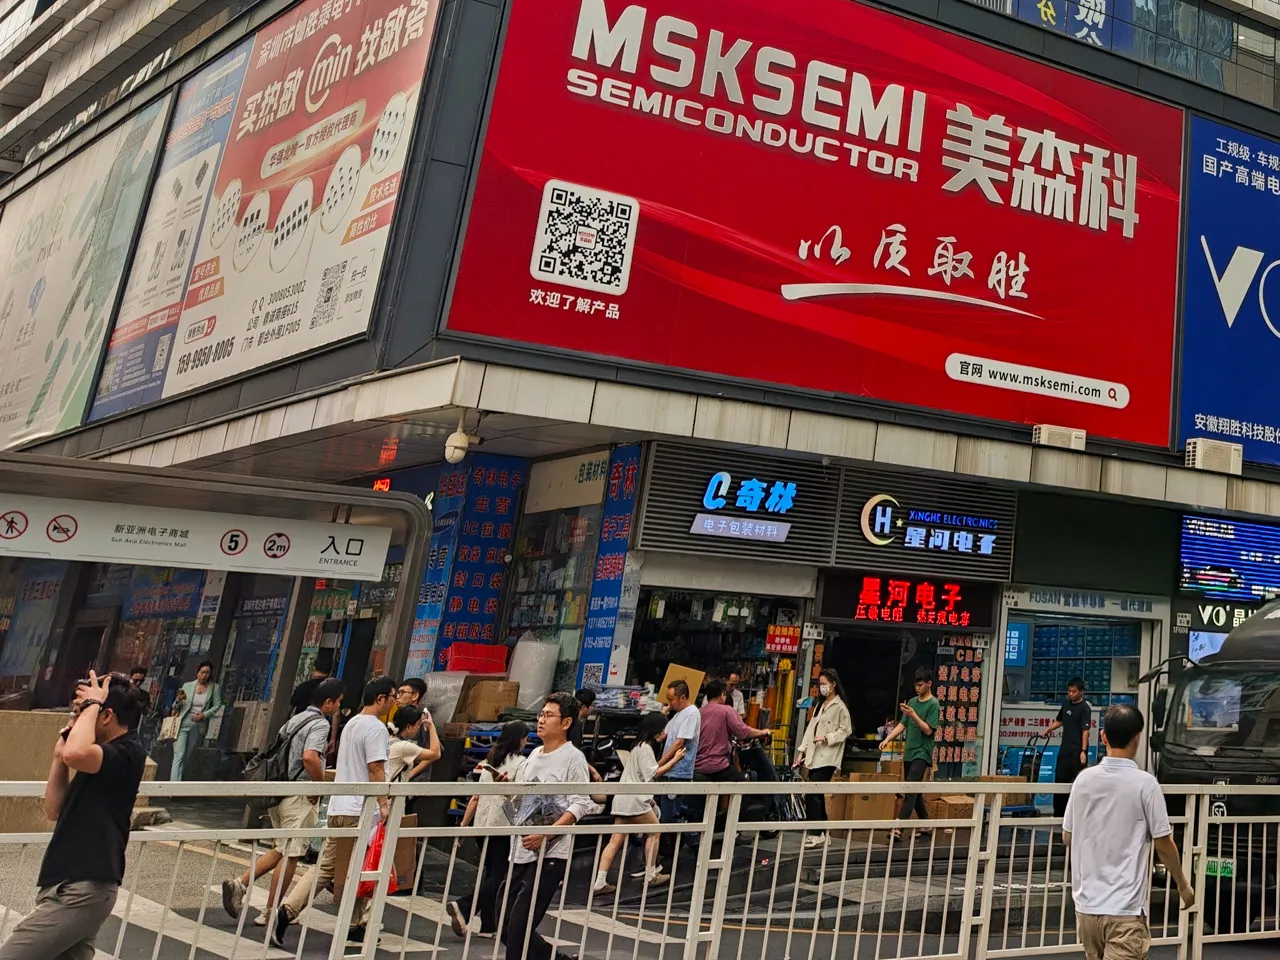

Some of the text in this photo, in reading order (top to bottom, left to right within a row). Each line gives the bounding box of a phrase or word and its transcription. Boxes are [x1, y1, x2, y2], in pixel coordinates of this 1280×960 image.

[566, 68, 919, 183] SEMICONDUCTOR
[941, 102, 1139, 238] 美森科
[799, 223, 1030, 300] 以质取胜
[529, 289, 620, 320] 欢迎了解产品
[959, 361, 1101, 398] 官网 www.msksemi.com
[473, 467, 522, 489] 奇林电子
[609, 456, 638, 501] 奇林
[473, 496, 512, 515] 主营
[736, 477, 797, 514] 奇林
[113, 523, 191, 540] 新亚洲电子商城
[703, 518, 779, 538] 电子包装材料
[943, 513, 998, 529] ELECTRONICS
[227, 534, 286, 553] 5 2m
[320, 536, 364, 556] 入口
[904, 527, 998, 555] 星河电子
[318, 558, 358, 567] ENTRANCE
[859, 577, 962, 611] 星河电子
[1029, 592, 1061, 605] FOSAN
[1198, 604, 1227, 627] VO
